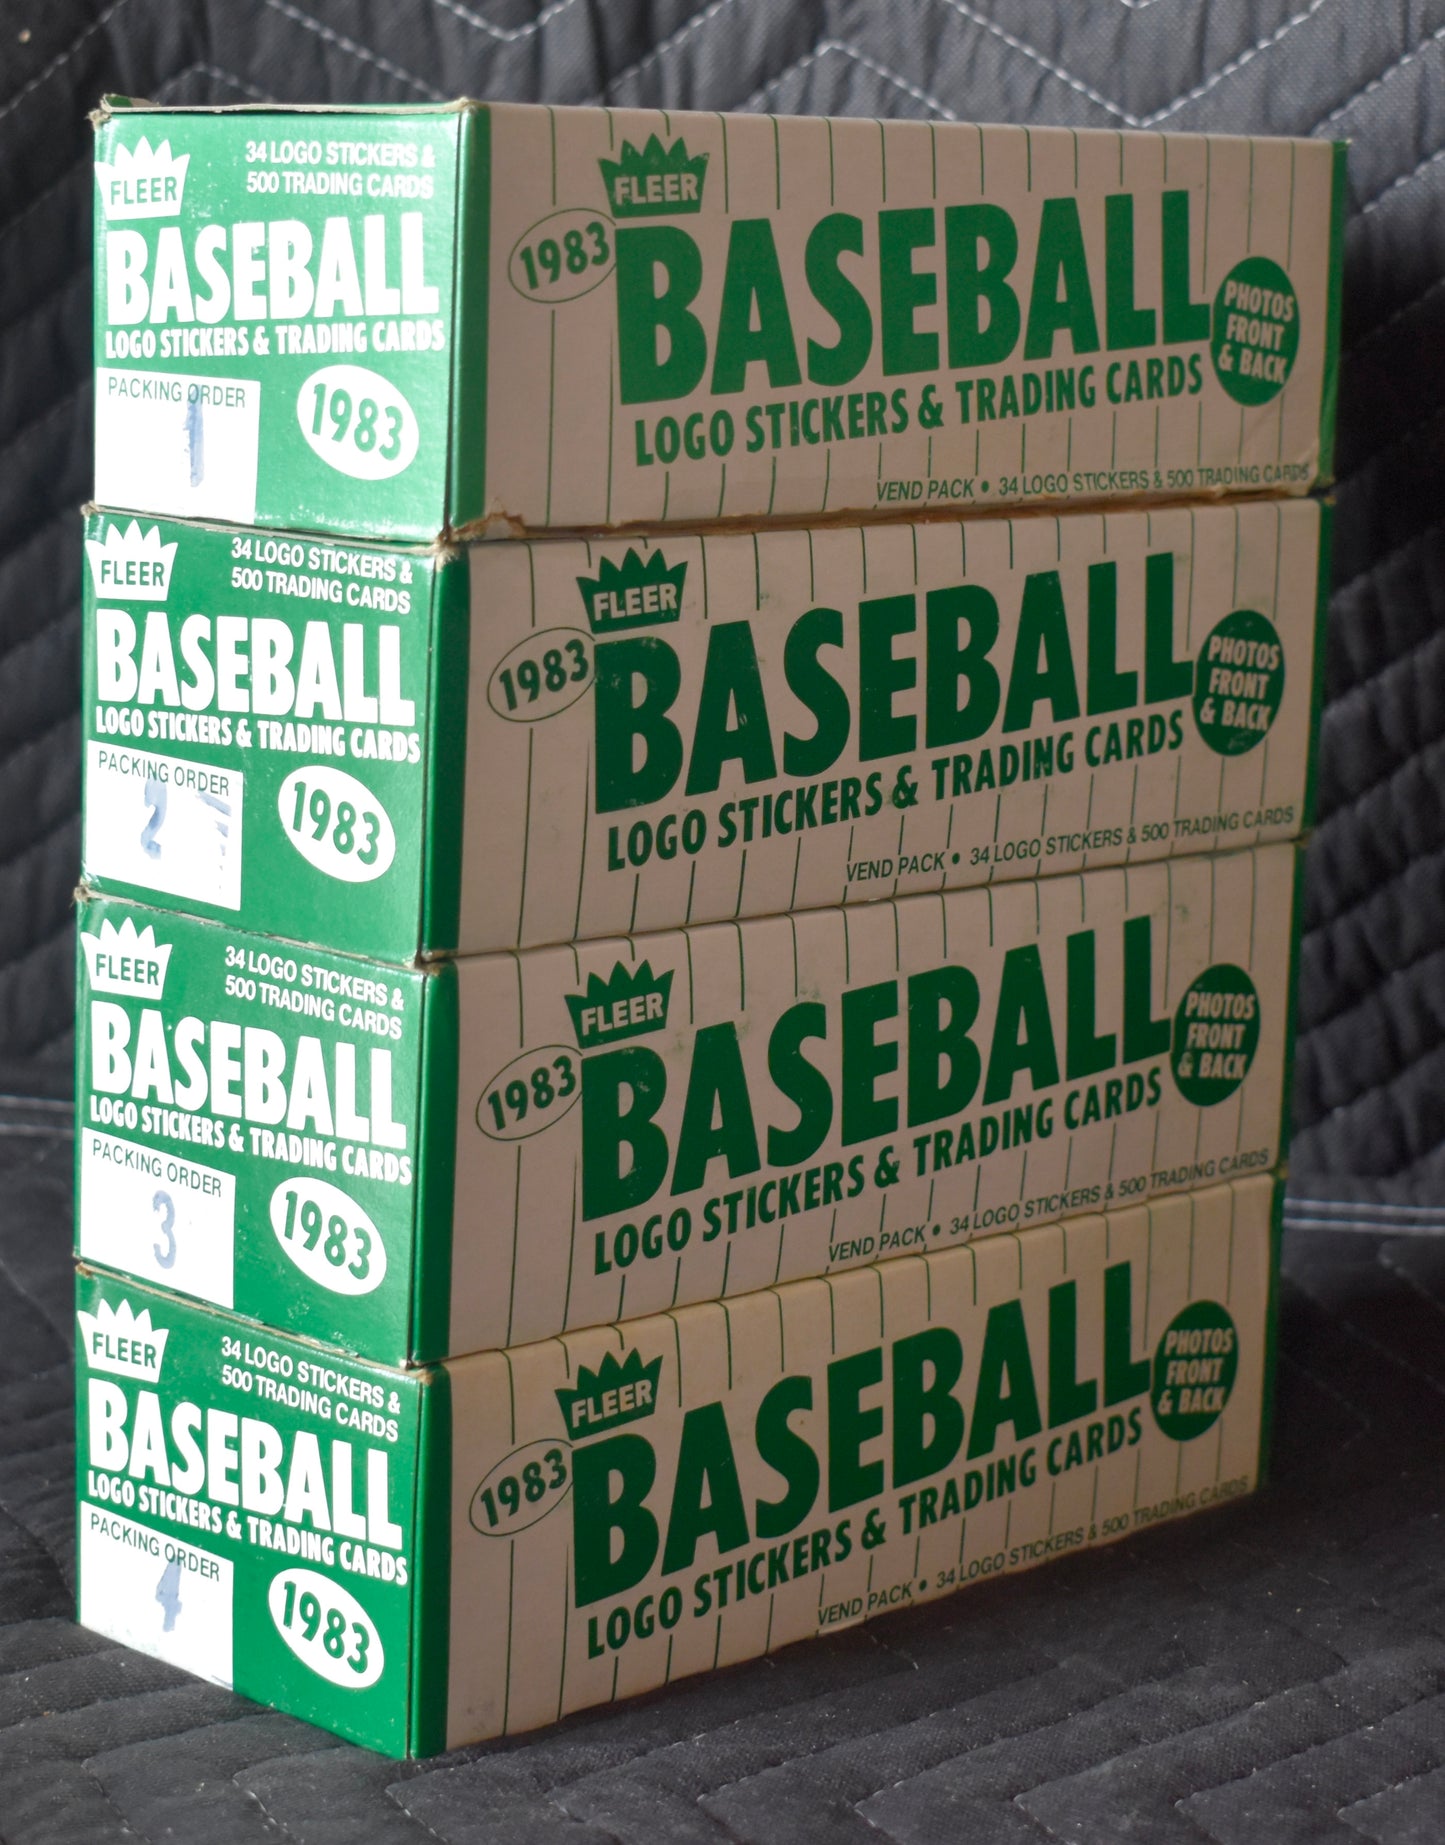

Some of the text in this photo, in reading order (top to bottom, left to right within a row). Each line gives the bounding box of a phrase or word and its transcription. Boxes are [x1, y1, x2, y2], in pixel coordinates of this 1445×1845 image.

[246, 141, 436, 168] 34 LOGO STICKERS &
[247, 172, 434, 199] 500 TRADING CARDS
[110, 176, 177, 205] FLEER
[614, 173, 698, 205] FLEER
[106, 212, 439, 325] BASEBALL
[520, 222, 610, 290] 1983
[614, 190, 1211, 405] BASEBALL
[1224, 281, 1294, 321] PHOTOS
[106, 321, 445, 359] LOGO STICKERS & TRADING CARDS
[1217, 344, 1288, 384] & BACK
[1226, 314, 1284, 350] FRONT
[109, 377, 246, 408] PACKING ORDER
[312, 383, 403, 460] 1983
[635, 354, 1202, 467] LOGO STICKERS & TRADING CARDS
[876, 463, 1309, 501] VEND PACK 34 LOGO STICKERS & 500 TRADING CARDS
[101, 560, 164, 586] FLEER
[231, 538, 413, 584] 34 LOGO STICKERS &
[232, 566, 411, 614] 500 TRADING CARDS
[593, 583, 677, 621] FLEER
[97, 608, 415, 727] BASEBALL
[499, 639, 588, 711] 1983
[594, 552, 1193, 814] BASEBALL
[1208, 635, 1279, 670] PHOTOS
[1210, 668, 1269, 699] FRONT
[96, 706, 421, 764] LOGO STICKERS & TRADING CARDS
[1200, 698, 1271, 730] & BACK
[99, 751, 229, 796] PACKING ORDER
[608, 710, 1183, 872] LOGO STICKERS & TRADING CARDS
[141, 780, 167, 859] 2
[293, 781, 380, 865] 1983
[846, 806, 1294, 882] VEND PACK 34 LOGO STICKERS & 500 TRADING CARDS
[96, 953, 159, 986] FLEER
[225, 946, 404, 1011] 34 LOGO STICKERS &
[225, 975, 402, 1040] 500 TRADING CARDS
[581, 992, 664, 1036] FLEER
[1186, 992, 1255, 1020] PHOTOS
[1186, 1024, 1246, 1048] FRONT
[91, 1000, 406, 1149] BASEBALL
[487, 1055, 576, 1131] 1983
[581, 915, 1171, 1222] BASEBALL
[1178, 1052, 1247, 1078] & BACK
[90, 1095, 412, 1185] LOGO STICKERS & TRADING CARDS
[92, 1139, 222, 1197] PACKING ORDER
[595, 1067, 1162, 1275] LOGO STICKERS & TRADING CARDS
[152, 1189, 176, 1269] 3
[285, 1190, 372, 1280] 1983
[828, 1148, 1269, 1262] VEND PACK 34 LOGO STICKERS & 500 TRADING CARDS
[93, 1332, 156, 1369] FLEER
[1165, 1328, 1233, 1356] PHOTOS
[1166, 1359, 1223, 1385] FRONT
[222, 1337, 400, 1414] 34 LOGO STICKERS &
[222, 1365, 398, 1442] 500 TRADING CARDS
[571, 1379, 653, 1427] FLEER
[1158, 1388, 1225, 1415] & BACK
[89, 1378, 402, 1550] BASEBALL
[571, 1260, 1151, 1609] BASEBALL
[481, 1448, 567, 1528] 1983
[88, 1470, 408, 1586] LOGO STICKERS & TRADING CARDS
[91, 1512, 220, 1582] PACKING ORDER
[588, 1407, 1142, 1659] LOGO STICKERS & TRADING CARDS
[818, 1476, 1248, 1626] VEND PACK 34 LOGO STICKERS & 500 TRADING CARDS
[155, 1564, 182, 1632] 4
[283, 1580, 370, 1674] 1983
